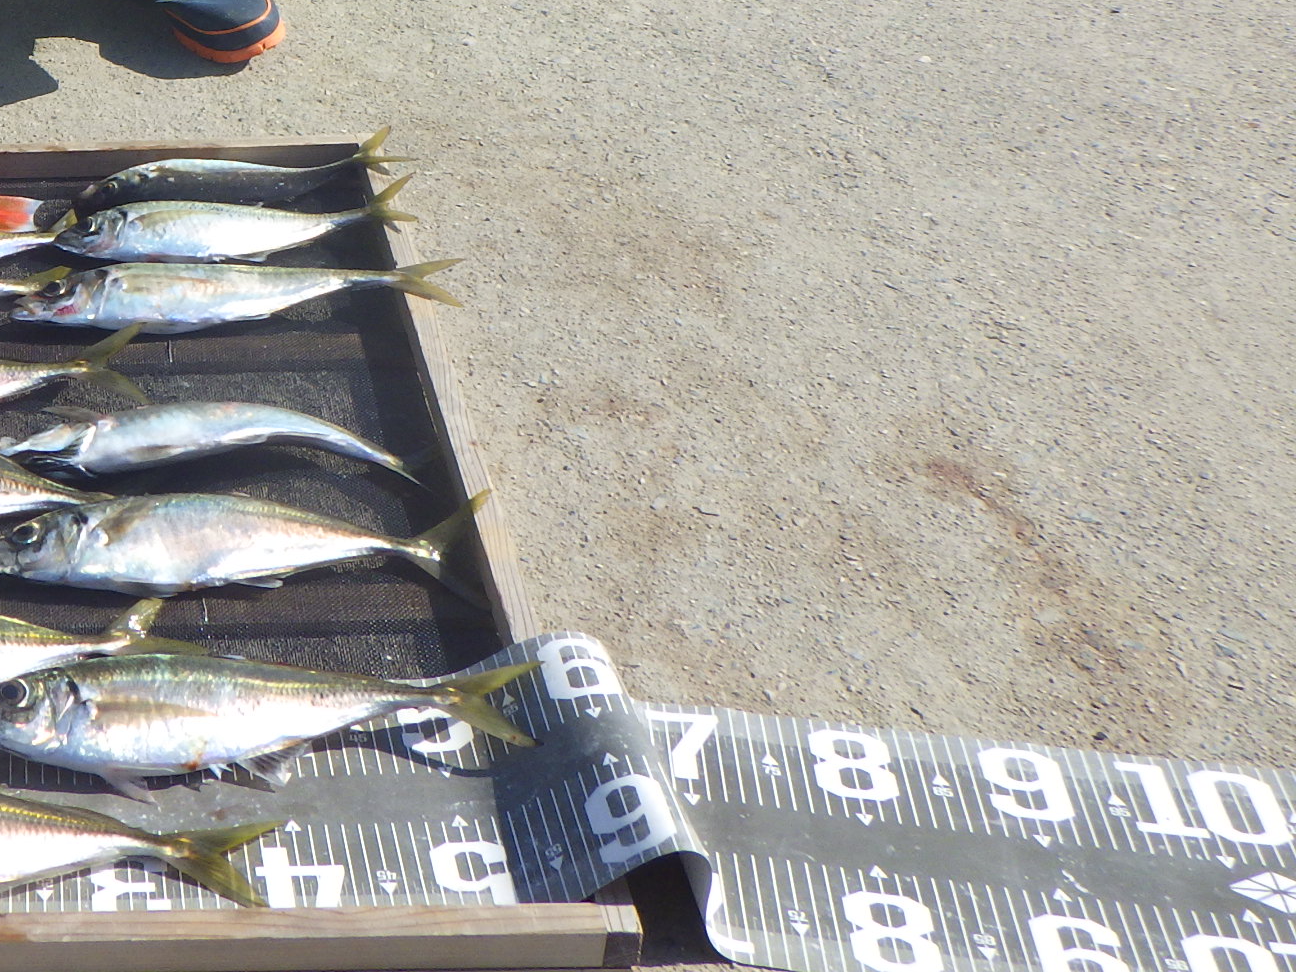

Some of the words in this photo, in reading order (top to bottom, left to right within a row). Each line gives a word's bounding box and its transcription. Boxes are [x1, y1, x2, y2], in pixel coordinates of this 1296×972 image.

[536, 637, 623, 701] 6
[644, 709, 719, 780] 7
[762, 763, 782, 776] 75
[807, 729, 900, 802] 8
[977, 747, 1076, 823] 9
[1108, 805, 1132, 818] 95
[1113, 760, 1295, 847] 10
[254, 846, 346, 909] 4
[842, 891, 945, 972] 8
